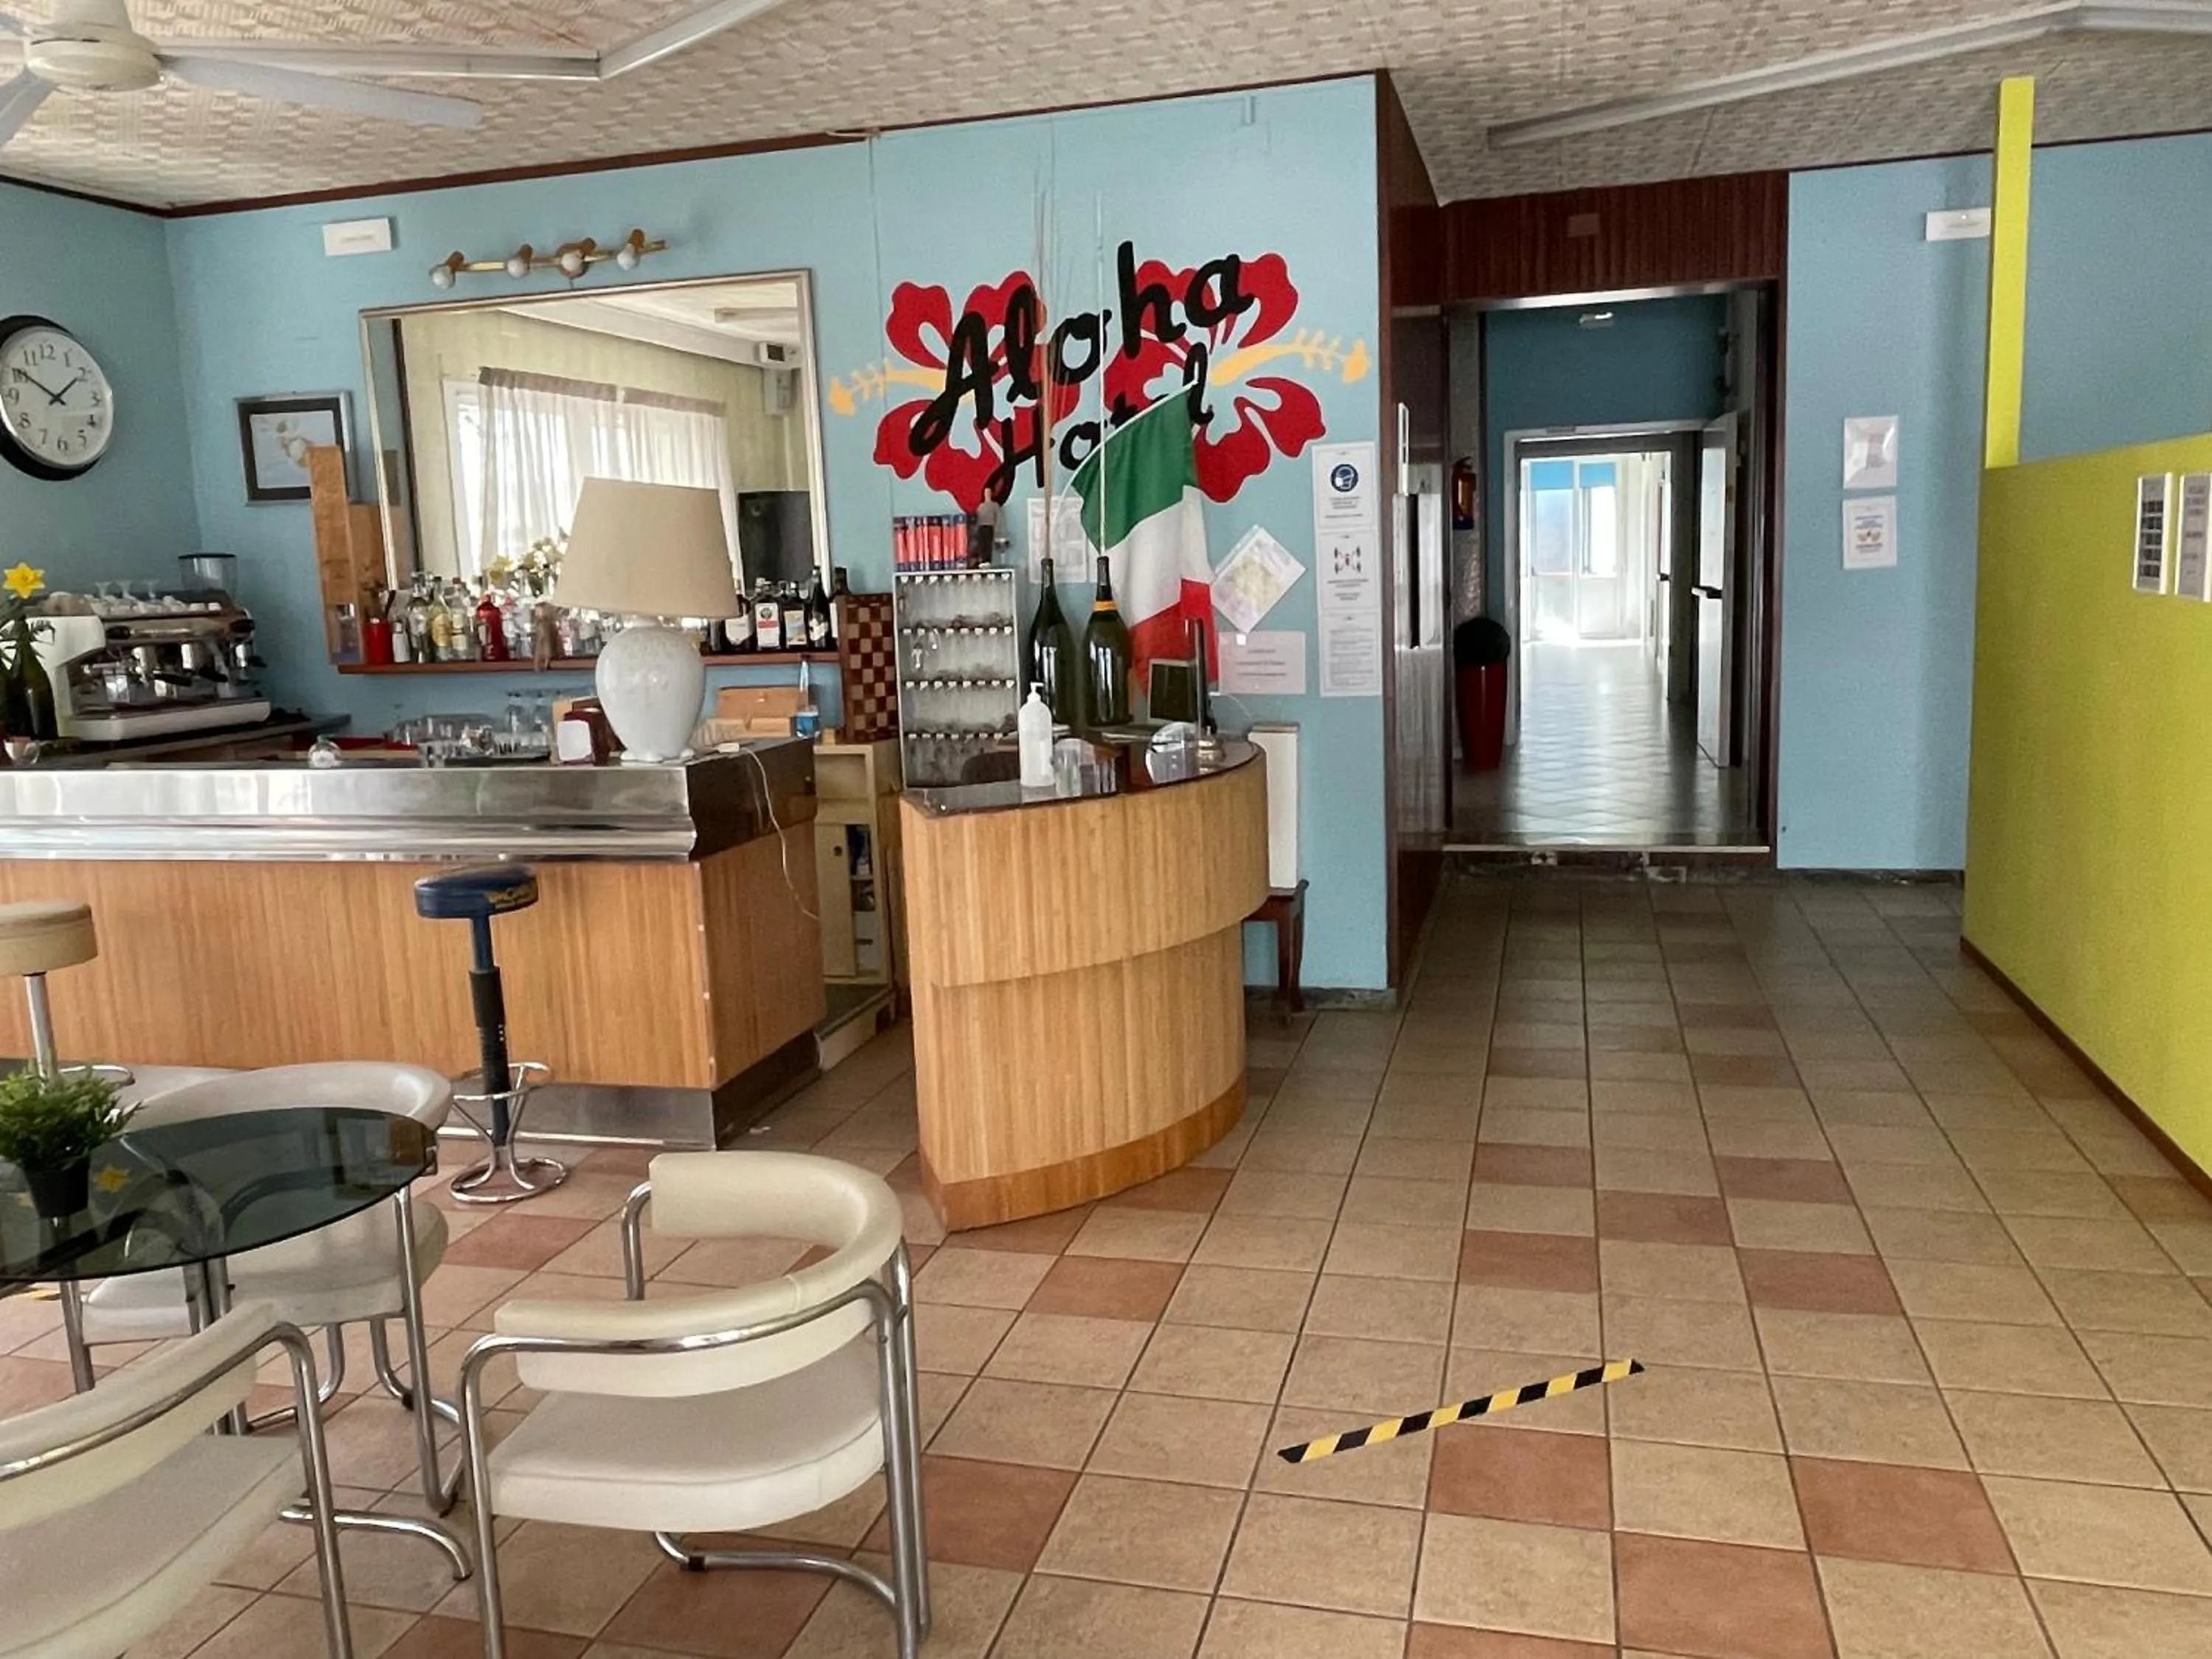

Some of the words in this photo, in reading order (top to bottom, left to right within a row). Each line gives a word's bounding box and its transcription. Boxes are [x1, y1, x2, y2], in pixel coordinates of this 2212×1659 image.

[39, 344, 56, 361] 12
[908, 240, 1254, 456] Aloha
[24, 349, 38, 366] 11
[18, 412, 31, 428] 8
[983, 342, 1214, 506] Hol
[38, 428, 48, 445] 7
